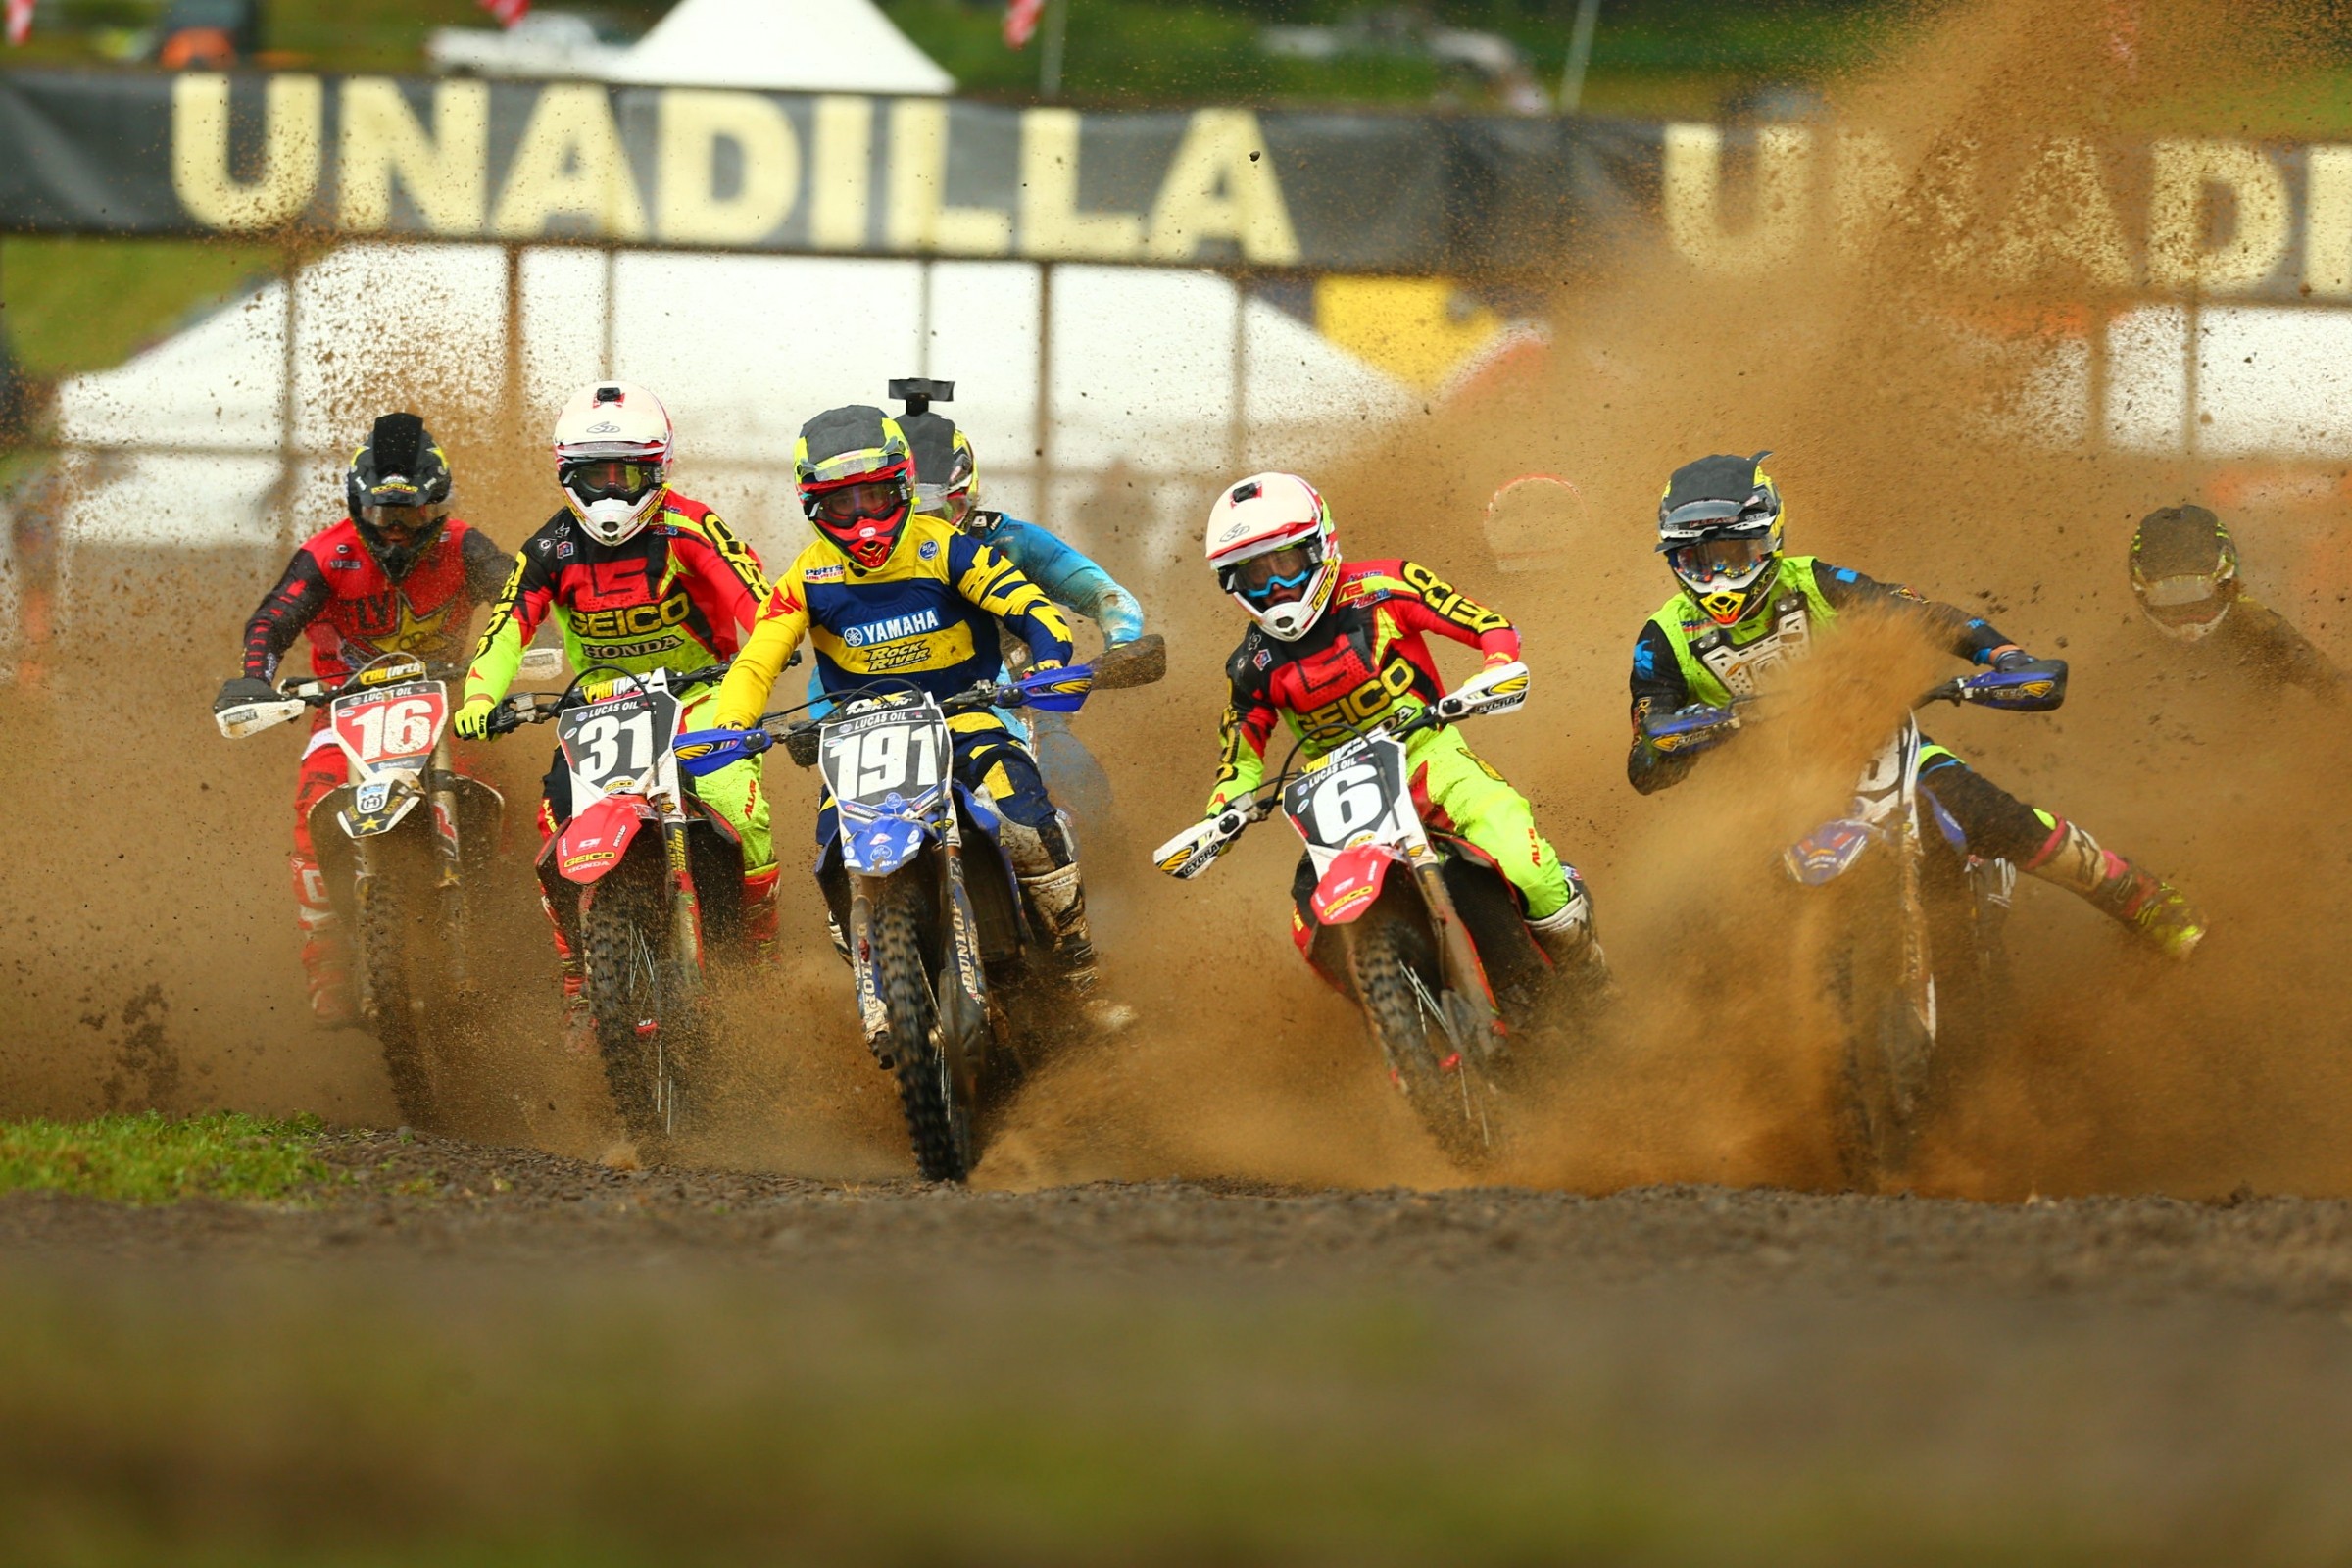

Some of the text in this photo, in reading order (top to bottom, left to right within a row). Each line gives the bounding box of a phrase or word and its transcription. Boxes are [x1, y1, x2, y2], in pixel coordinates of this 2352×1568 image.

[172, 74, 1300, 265] UNADILLA
[568, 592, 691, 637] GEICO
[863, 610, 939, 644] YAMAHA
[583, 636, 683, 658] HONDA
[868, 649, 930, 672] RIVER
[869, 641, 925, 662] ROCK
[396, 687, 413, 696] OIL
[1295, 657, 1415, 742] GEICO
[1476, 697, 1517, 714] CYCRA
[589, 700, 639, 719] LUCAS OIL
[854, 711, 907, 731] LUCAS OIL
[351, 699, 434, 761] 16
[578, 710, 654, 783] 31
[829, 725, 944, 802] 191
[1308, 757, 1357, 788] LUCAS OIL
[603, 779, 635, 793] GEICO
[1312, 764, 1383, 845] 6
[564, 851, 616, 868] GEICO
[566, 860, 611, 874] HONDA
[1184, 842, 1220, 876] CYCRA
[1324, 885, 1373, 917] GEICO
